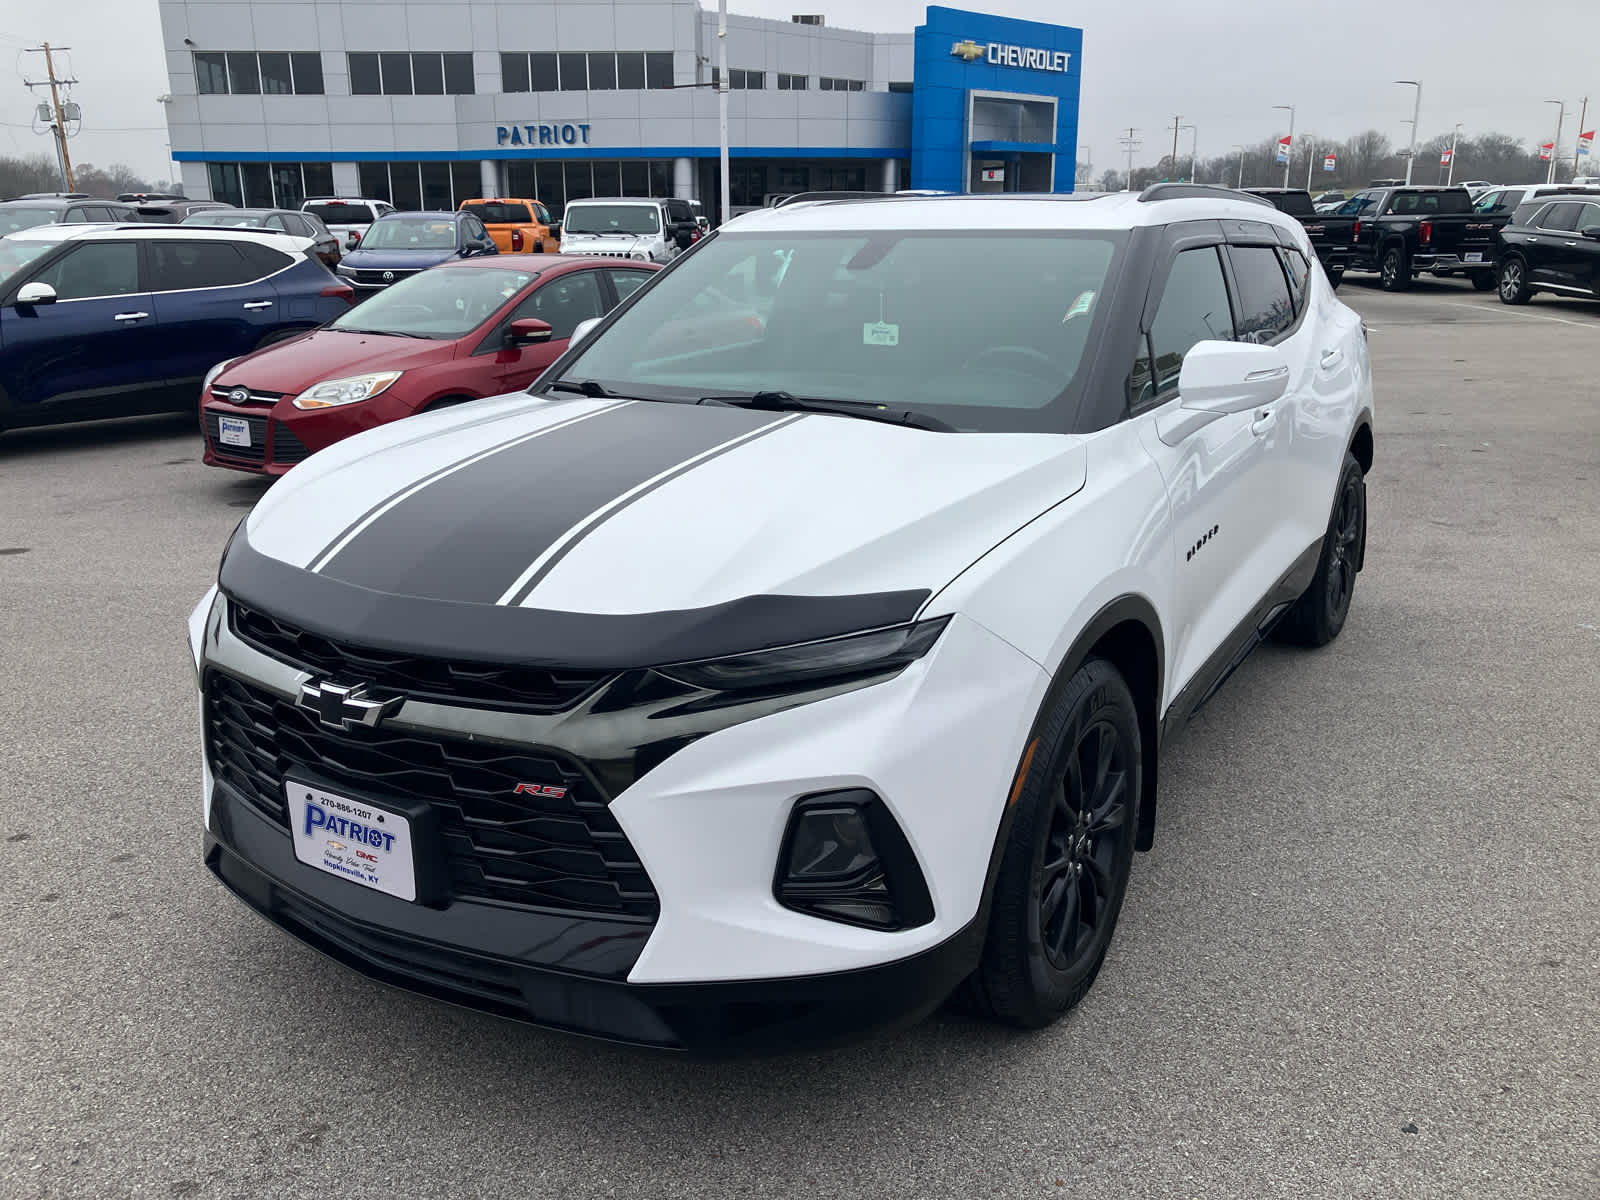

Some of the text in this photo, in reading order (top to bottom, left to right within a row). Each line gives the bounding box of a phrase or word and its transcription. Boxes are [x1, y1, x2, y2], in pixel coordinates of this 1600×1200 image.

[987, 42, 1071, 72] CHEVROLET
[496, 124, 591, 146] PATRIOT
[513, 783, 567, 799] RS
[320, 797, 372, 820] 270-886-1207
[304, 802, 396, 852] PATRIOT
[355, 849, 378, 863] GMC
[323, 858, 379, 885] Hopkinsville, KY
